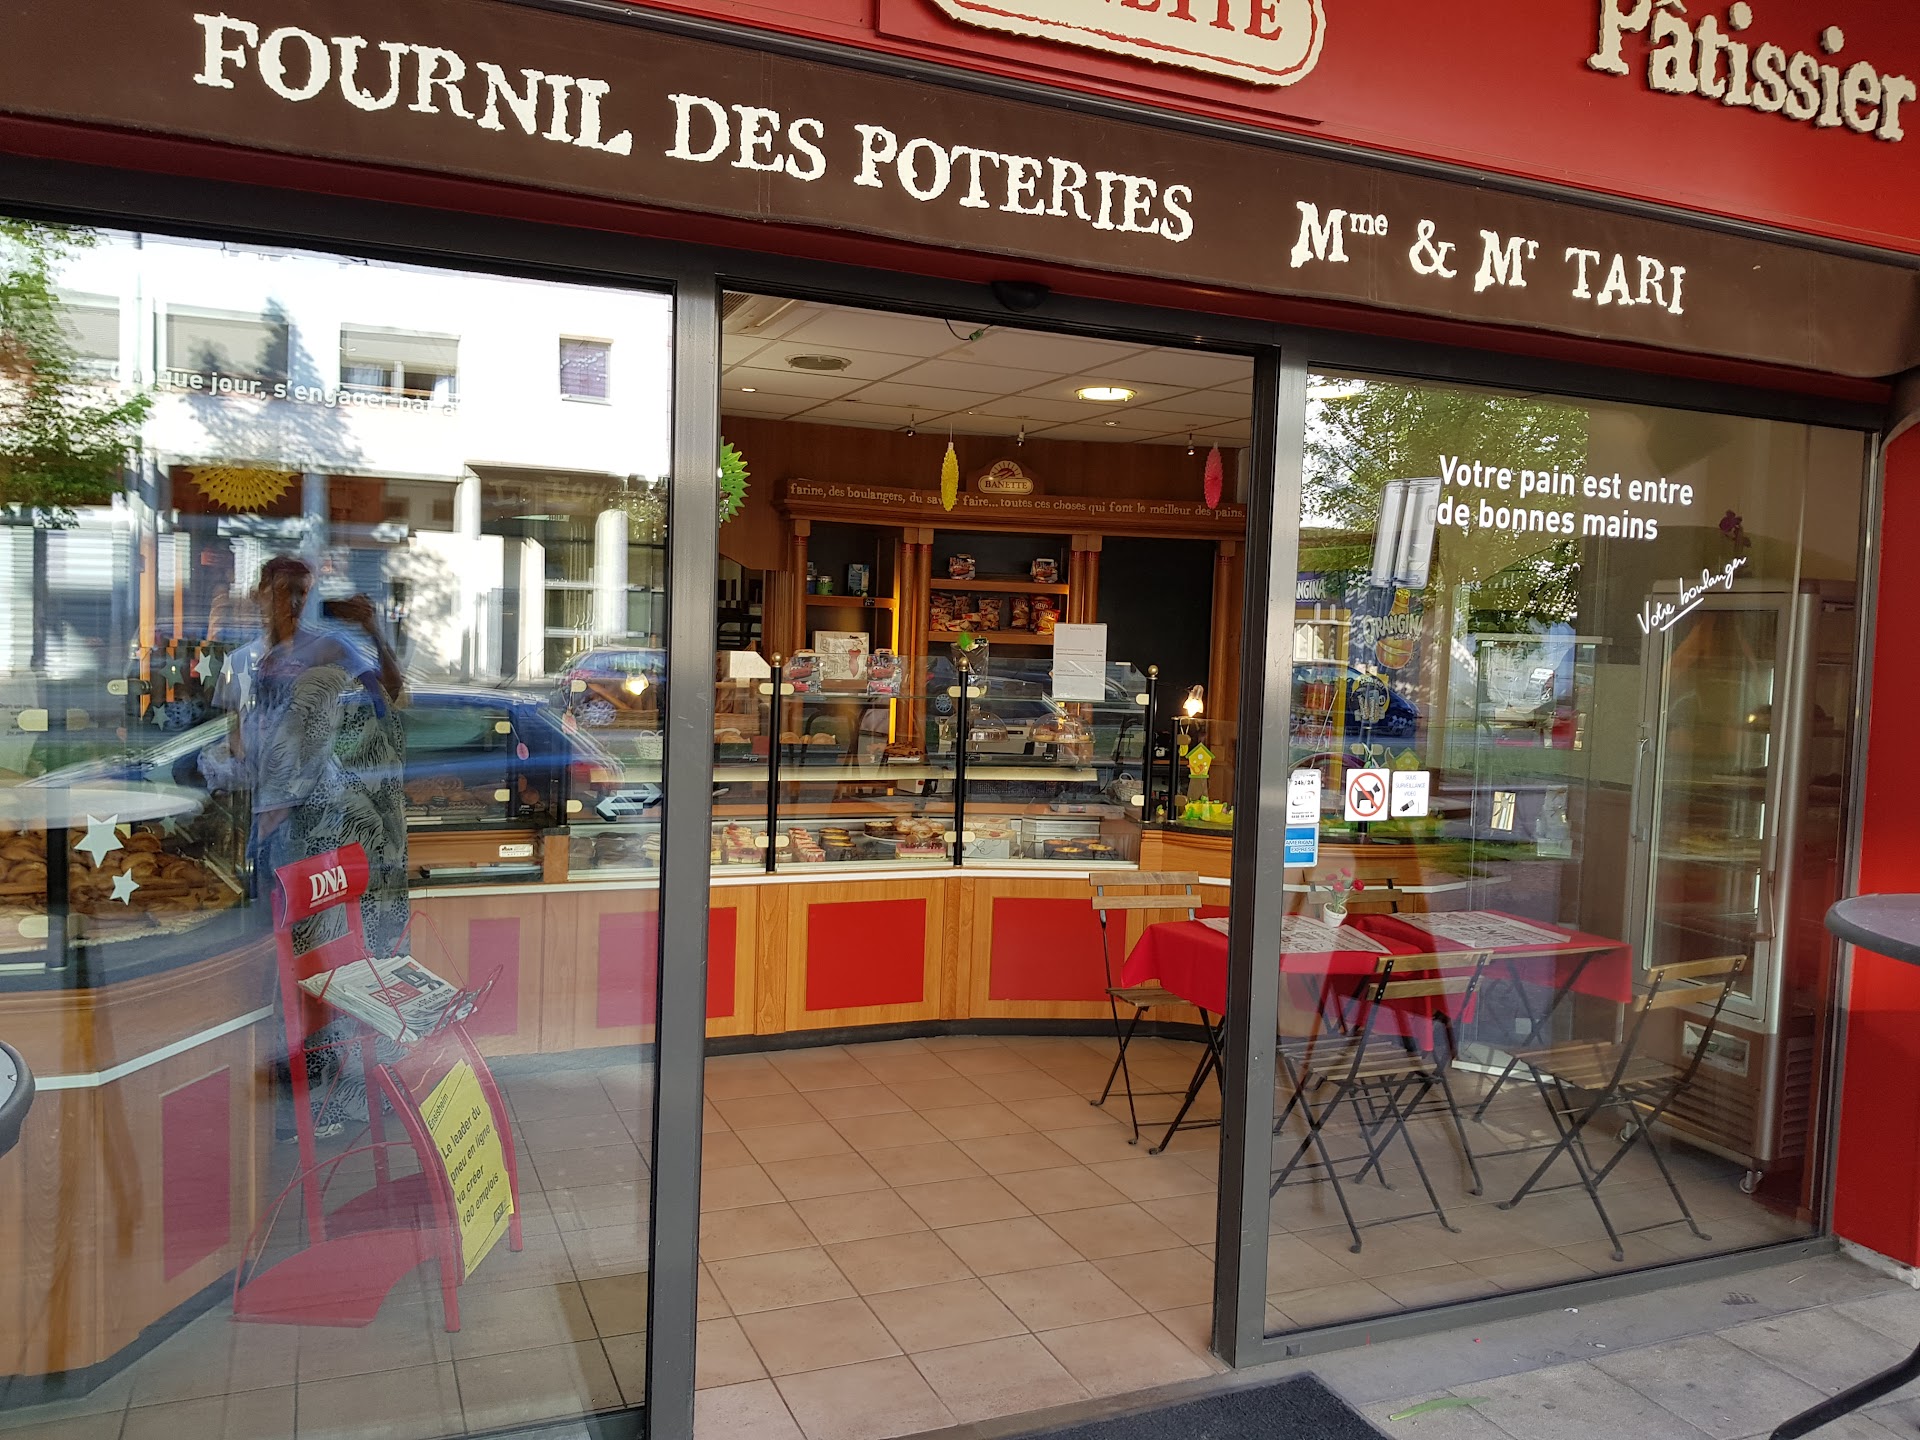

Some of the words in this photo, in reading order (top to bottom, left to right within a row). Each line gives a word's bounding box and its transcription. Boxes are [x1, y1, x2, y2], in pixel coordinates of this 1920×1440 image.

[1586, 0, 1917, 142] Pâtissier
[194, 13, 632, 155] FOURNIL
[665, 94, 826, 181] DES
[854, 123, 1194, 242] POTERIES
[1291, 201, 1388, 268] Mme
[1409, 220, 1457, 278] &
[1474, 230, 1539, 292] Mr
[1570, 247, 1686, 315] TARI
[209, 372, 267, 400] jour,
[790, 482, 827, 499] farine,
[828, 485, 846, 498] des
[847, 486, 906, 505] boulangers,
[909, 491, 923, 504] du
[1000, 498, 1032, 508] toutes
[1034, 500, 1051, 509] ces
[1053, 499, 1086, 511] choses
[1088, 501, 1106, 515] qui
[1109, 501, 1133, 513] font
[1137, 502, 1146, 513] le
[1149, 503, 1191, 515] meilleur
[1195, 504, 1212, 516] des
[1215, 507, 1246, 520] pains.
[985, 480, 1028, 490] BANETTE
[1439, 455, 1512, 490] Votre
[1520, 469, 1575, 499] pain
[1584, 473, 1622, 499] est
[1629, 478, 1693, 506] entre
[1438, 497, 1470, 527] de
[1479, 504, 1575, 534] bonnes
[1583, 512, 1658, 541] mains
[1679, 556, 1747, 606] boulanger
[309, 865, 348, 902] DNA
[427, 1093, 449, 1130] Ensisheim
[441, 1143, 453, 1160] Le
[450, 1116, 473, 1148] leader
[471, 1105, 482, 1121] du
[450, 1156, 468, 1186] pneu
[467, 1144, 476, 1160] en
[474, 1124, 491, 1149] ligne
[456, 1190, 466, 1205] va
[475, 1172, 499, 1211] emplois
